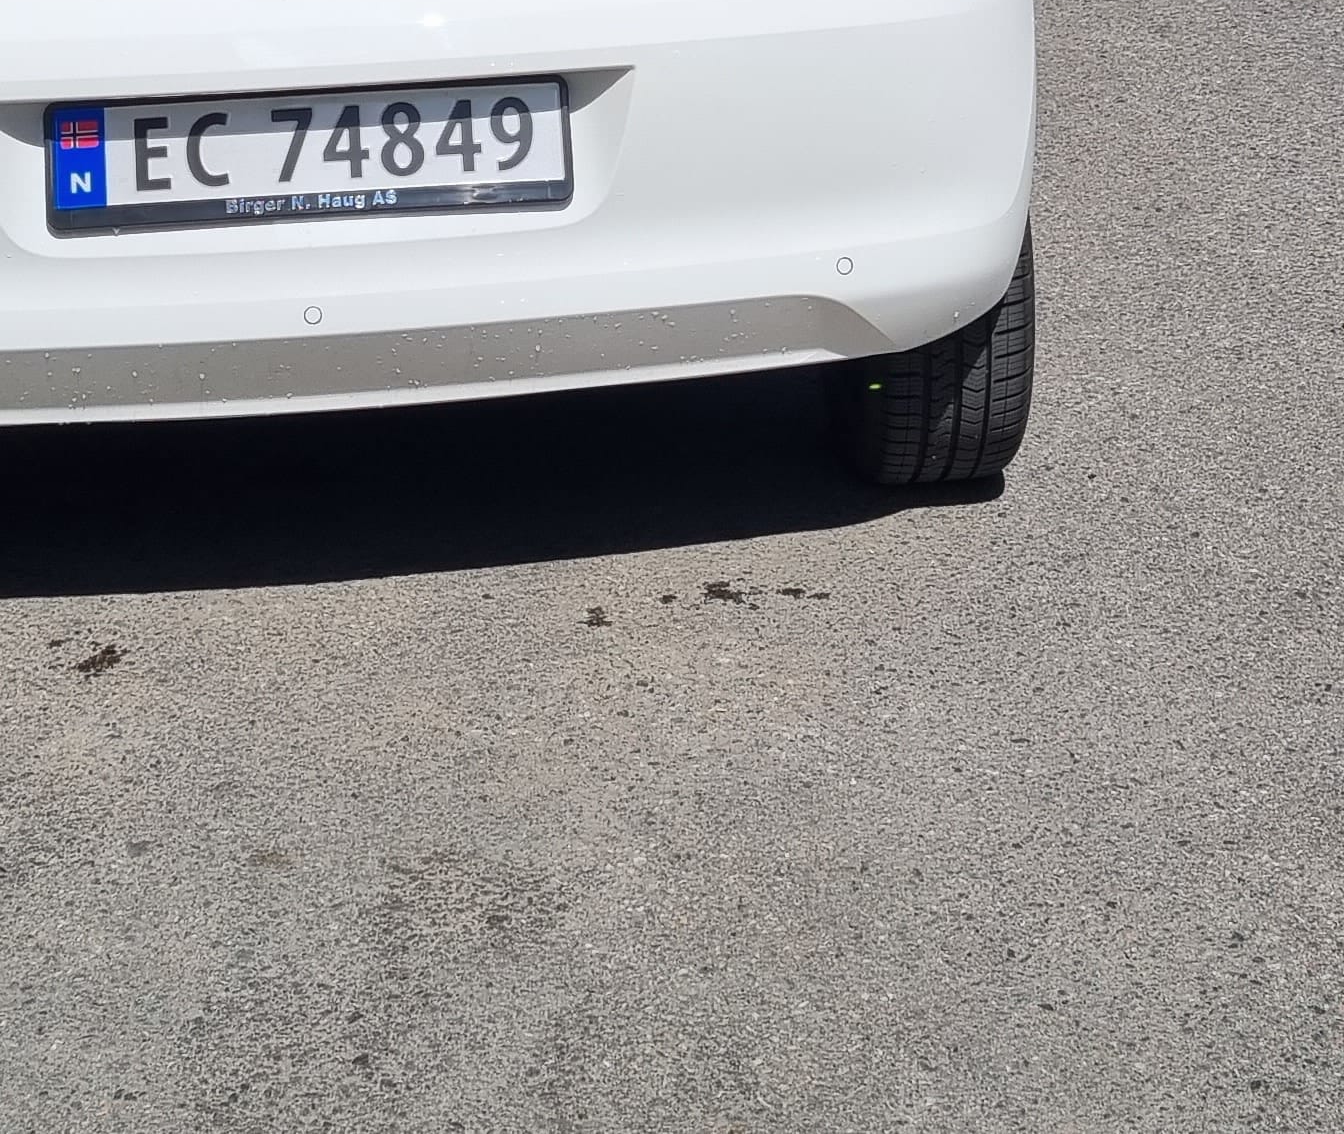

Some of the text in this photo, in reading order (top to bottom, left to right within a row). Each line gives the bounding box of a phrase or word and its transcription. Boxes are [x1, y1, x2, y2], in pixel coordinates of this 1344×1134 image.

[134, 96, 534, 191] EC 74849
[70, 173, 92, 193] N
[225, 189, 397, 215] Birger N. Haug AS
